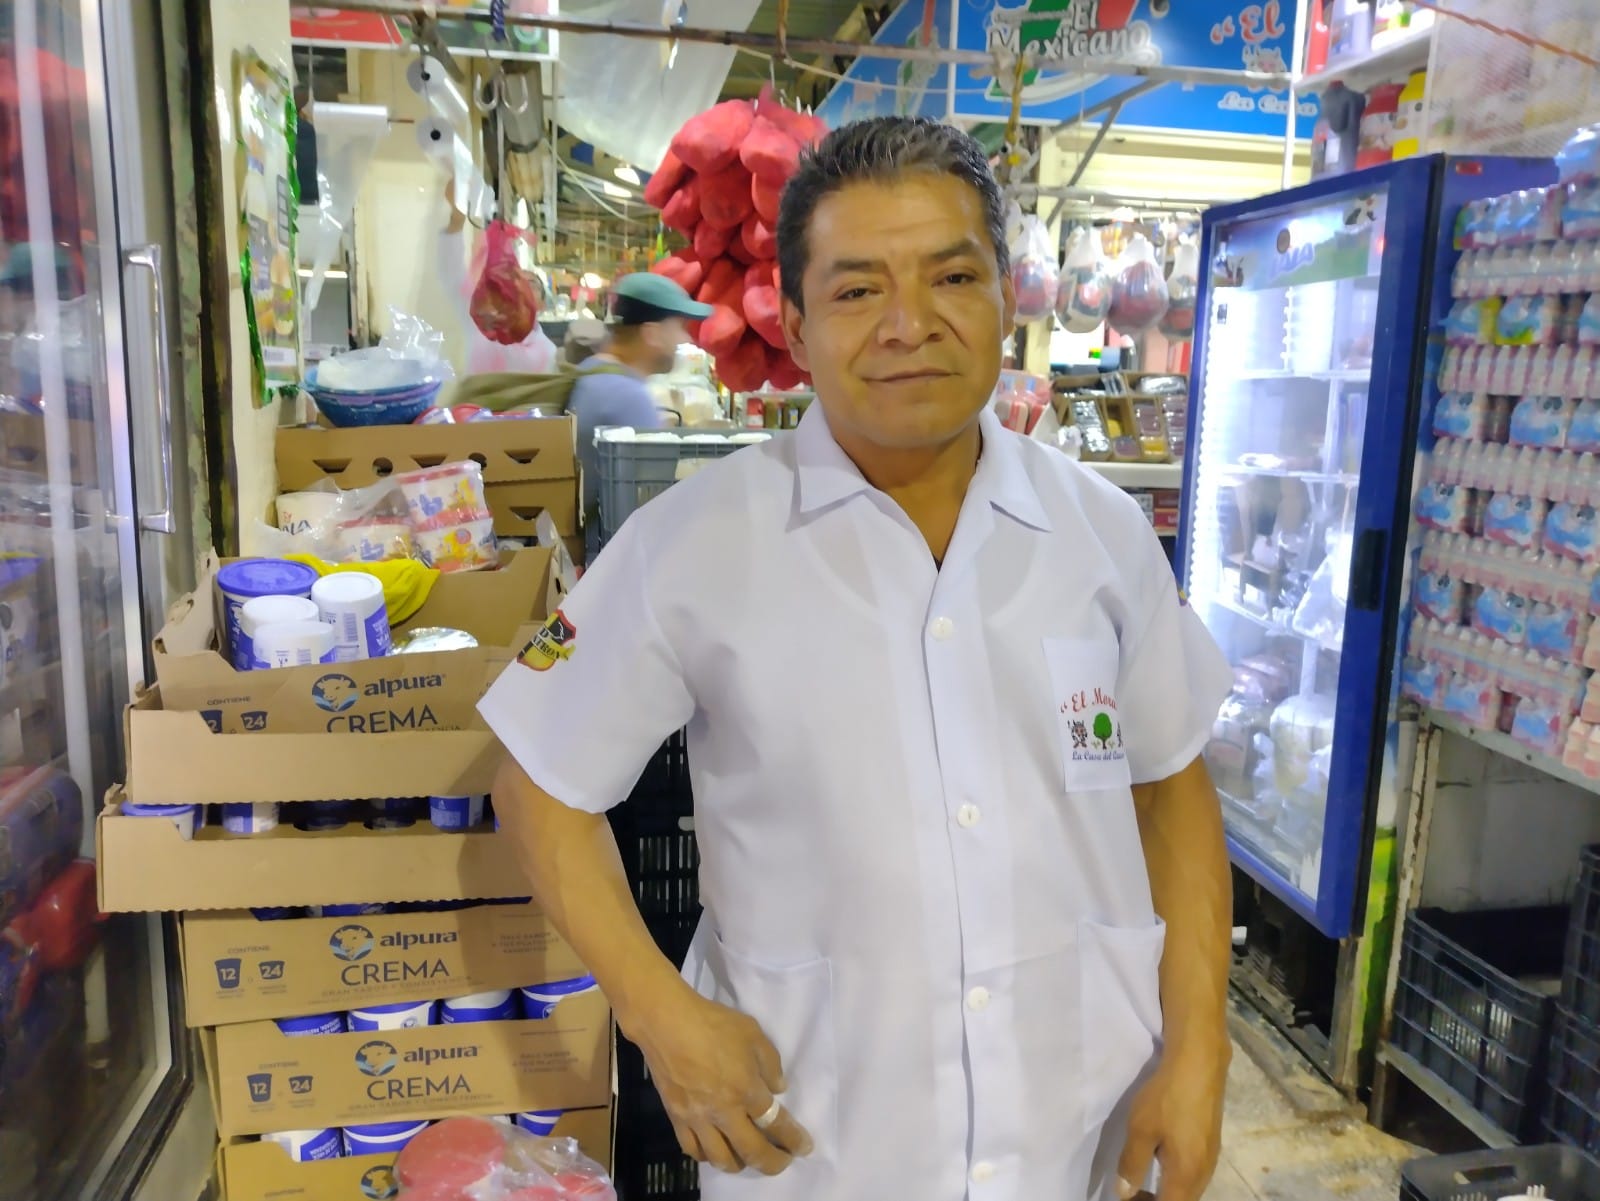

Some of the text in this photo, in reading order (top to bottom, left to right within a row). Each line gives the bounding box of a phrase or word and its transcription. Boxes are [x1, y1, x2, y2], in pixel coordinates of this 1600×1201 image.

[1072, 0, 1098, 30] El
[986, 19, 1151, 60] Mexicano
[364, 674, 442, 698] alpura
[244, 715, 264, 729] 24
[326, 704, 438, 733] CREMA
[380, 931, 457, 950] alpura
[220, 967, 236, 981] 12
[262, 965, 282, 978] 24
[341, 958, 449, 986] CREMA
[403, 1047, 477, 1066] alpura
[251, 1079, 311, 1096] 12 24
[367, 1073, 471, 1101] CREMA
